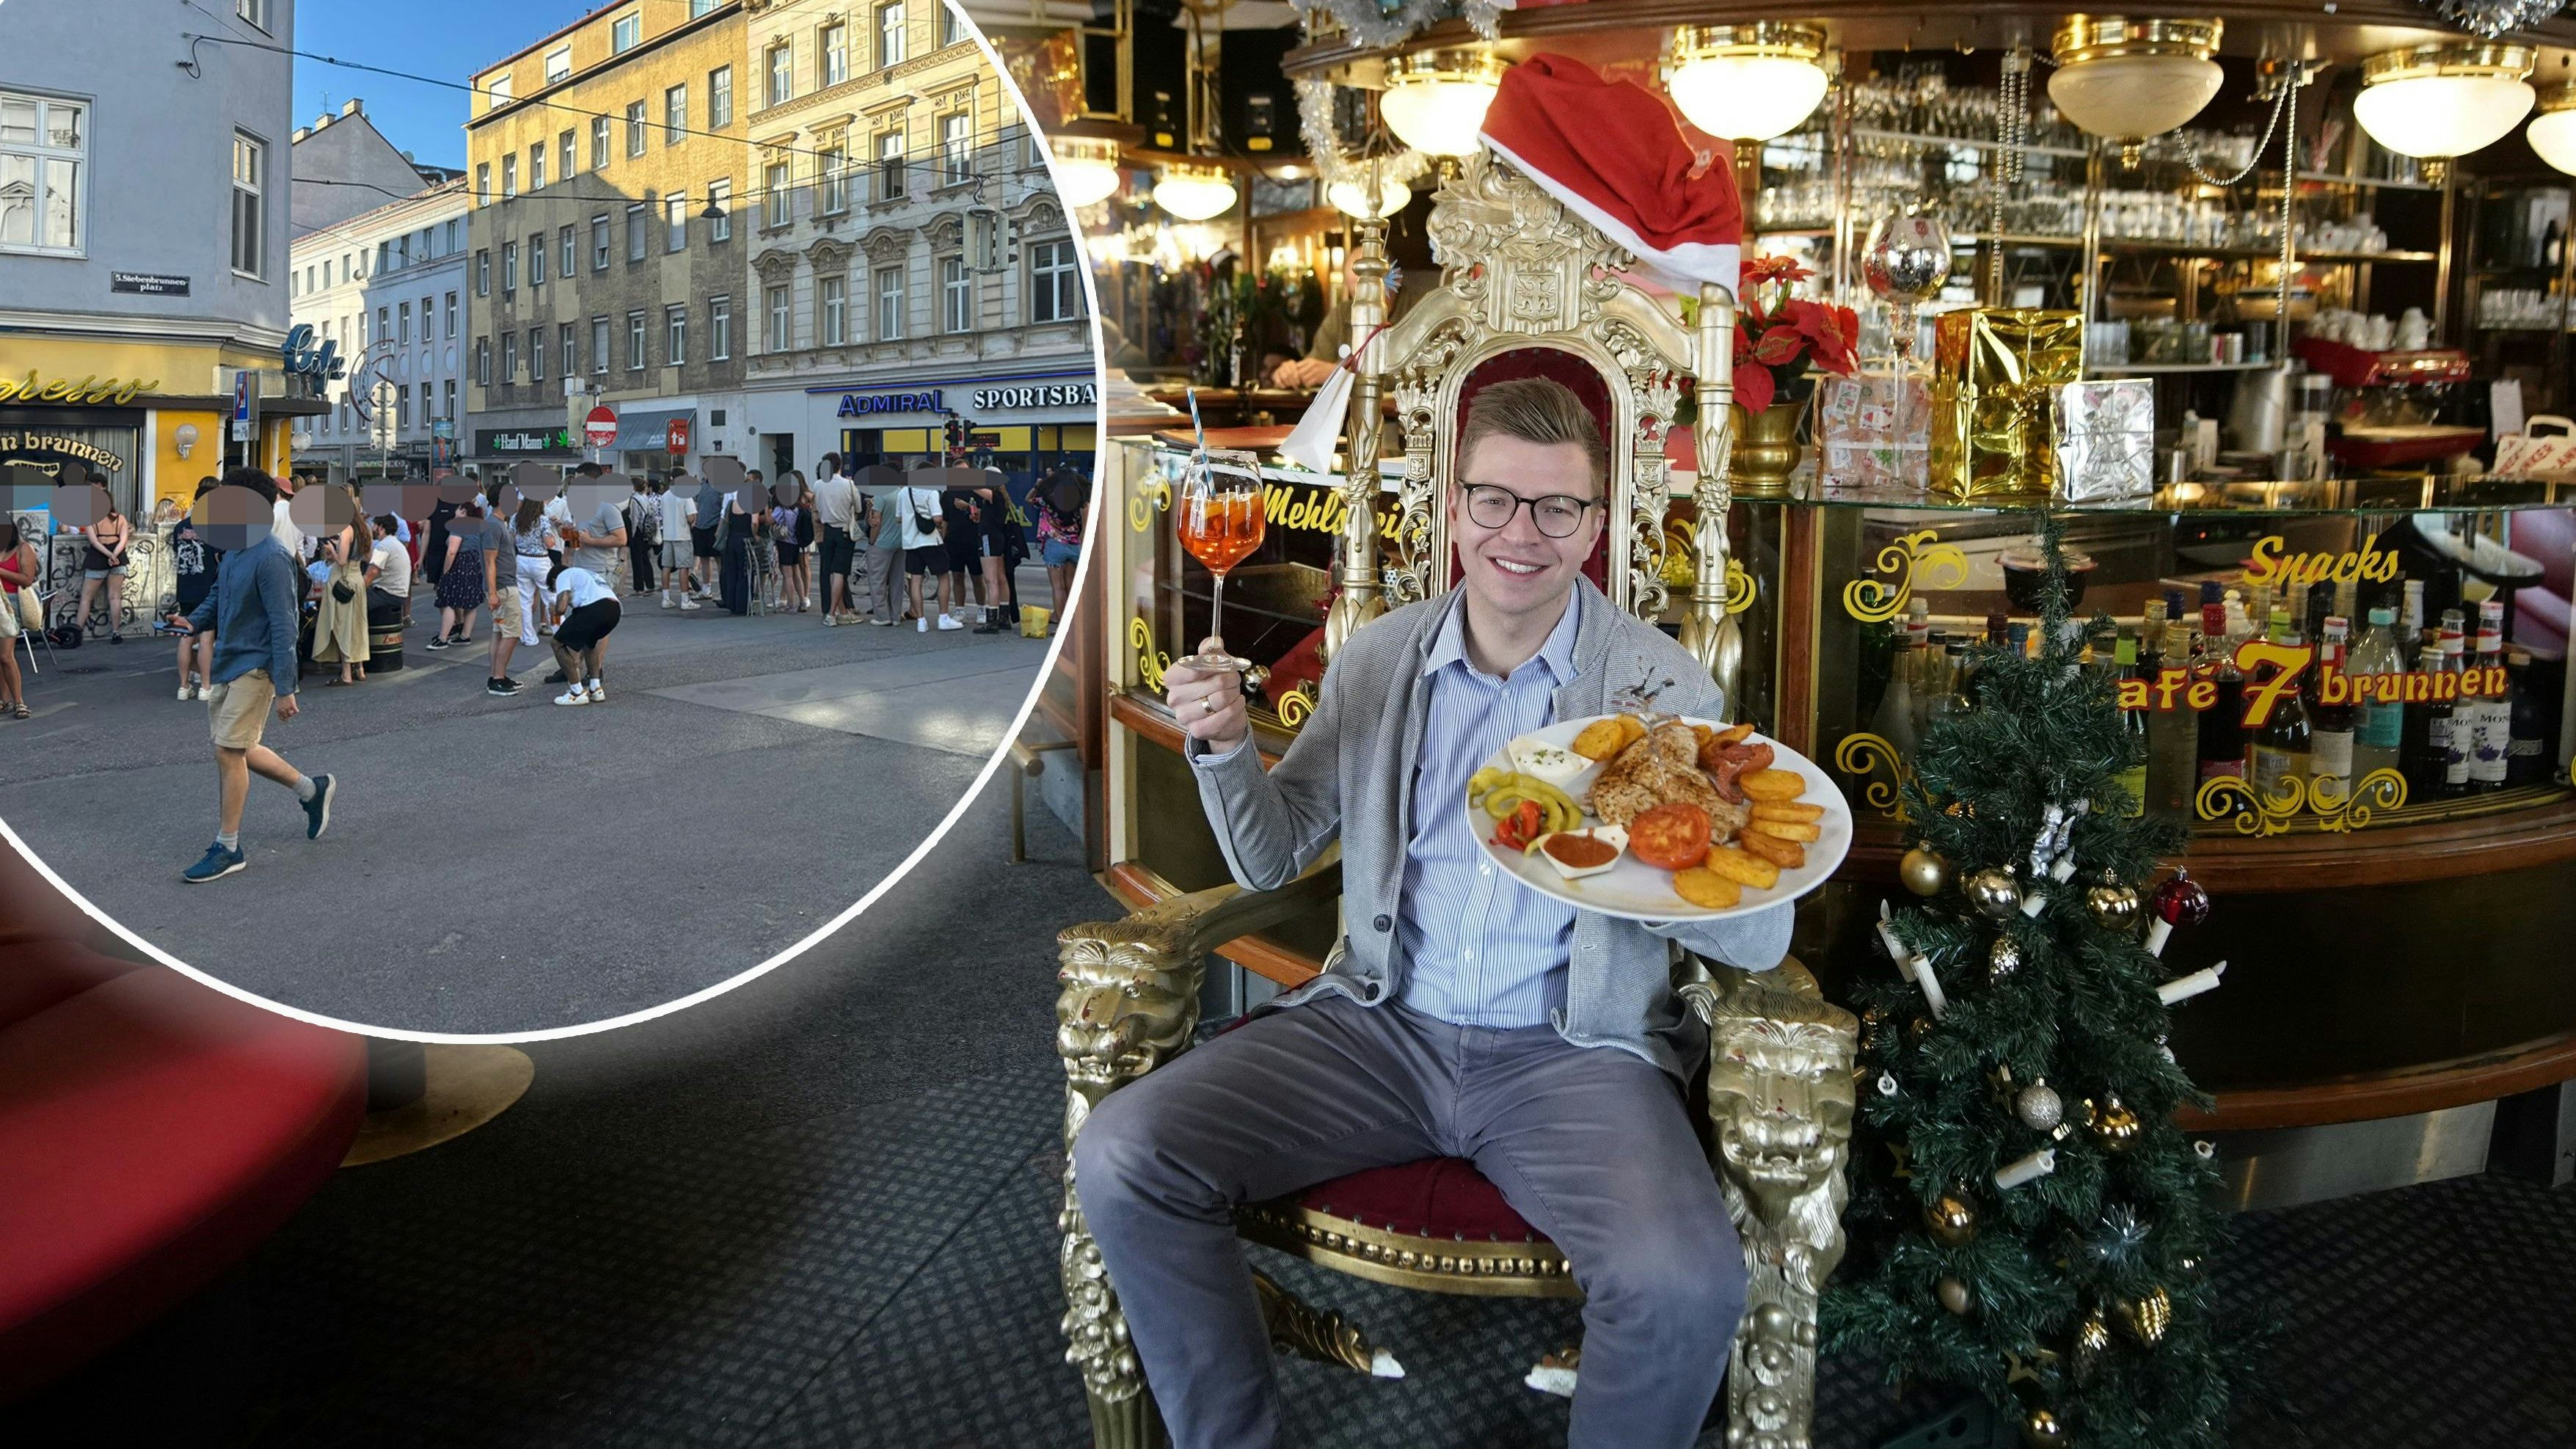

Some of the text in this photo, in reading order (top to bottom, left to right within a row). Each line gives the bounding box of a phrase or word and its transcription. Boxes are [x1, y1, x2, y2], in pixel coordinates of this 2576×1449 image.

[139, 284, 163, 292] platz
[837, 390, 953, 417] ADMIRAL
[24, 431, 123, 472] brunnen
[520, 433, 543, 450] Mann
[2241, 533, 2400, 587] Snacks
[2116, 640, 2509, 729] afé 7 brunnen
